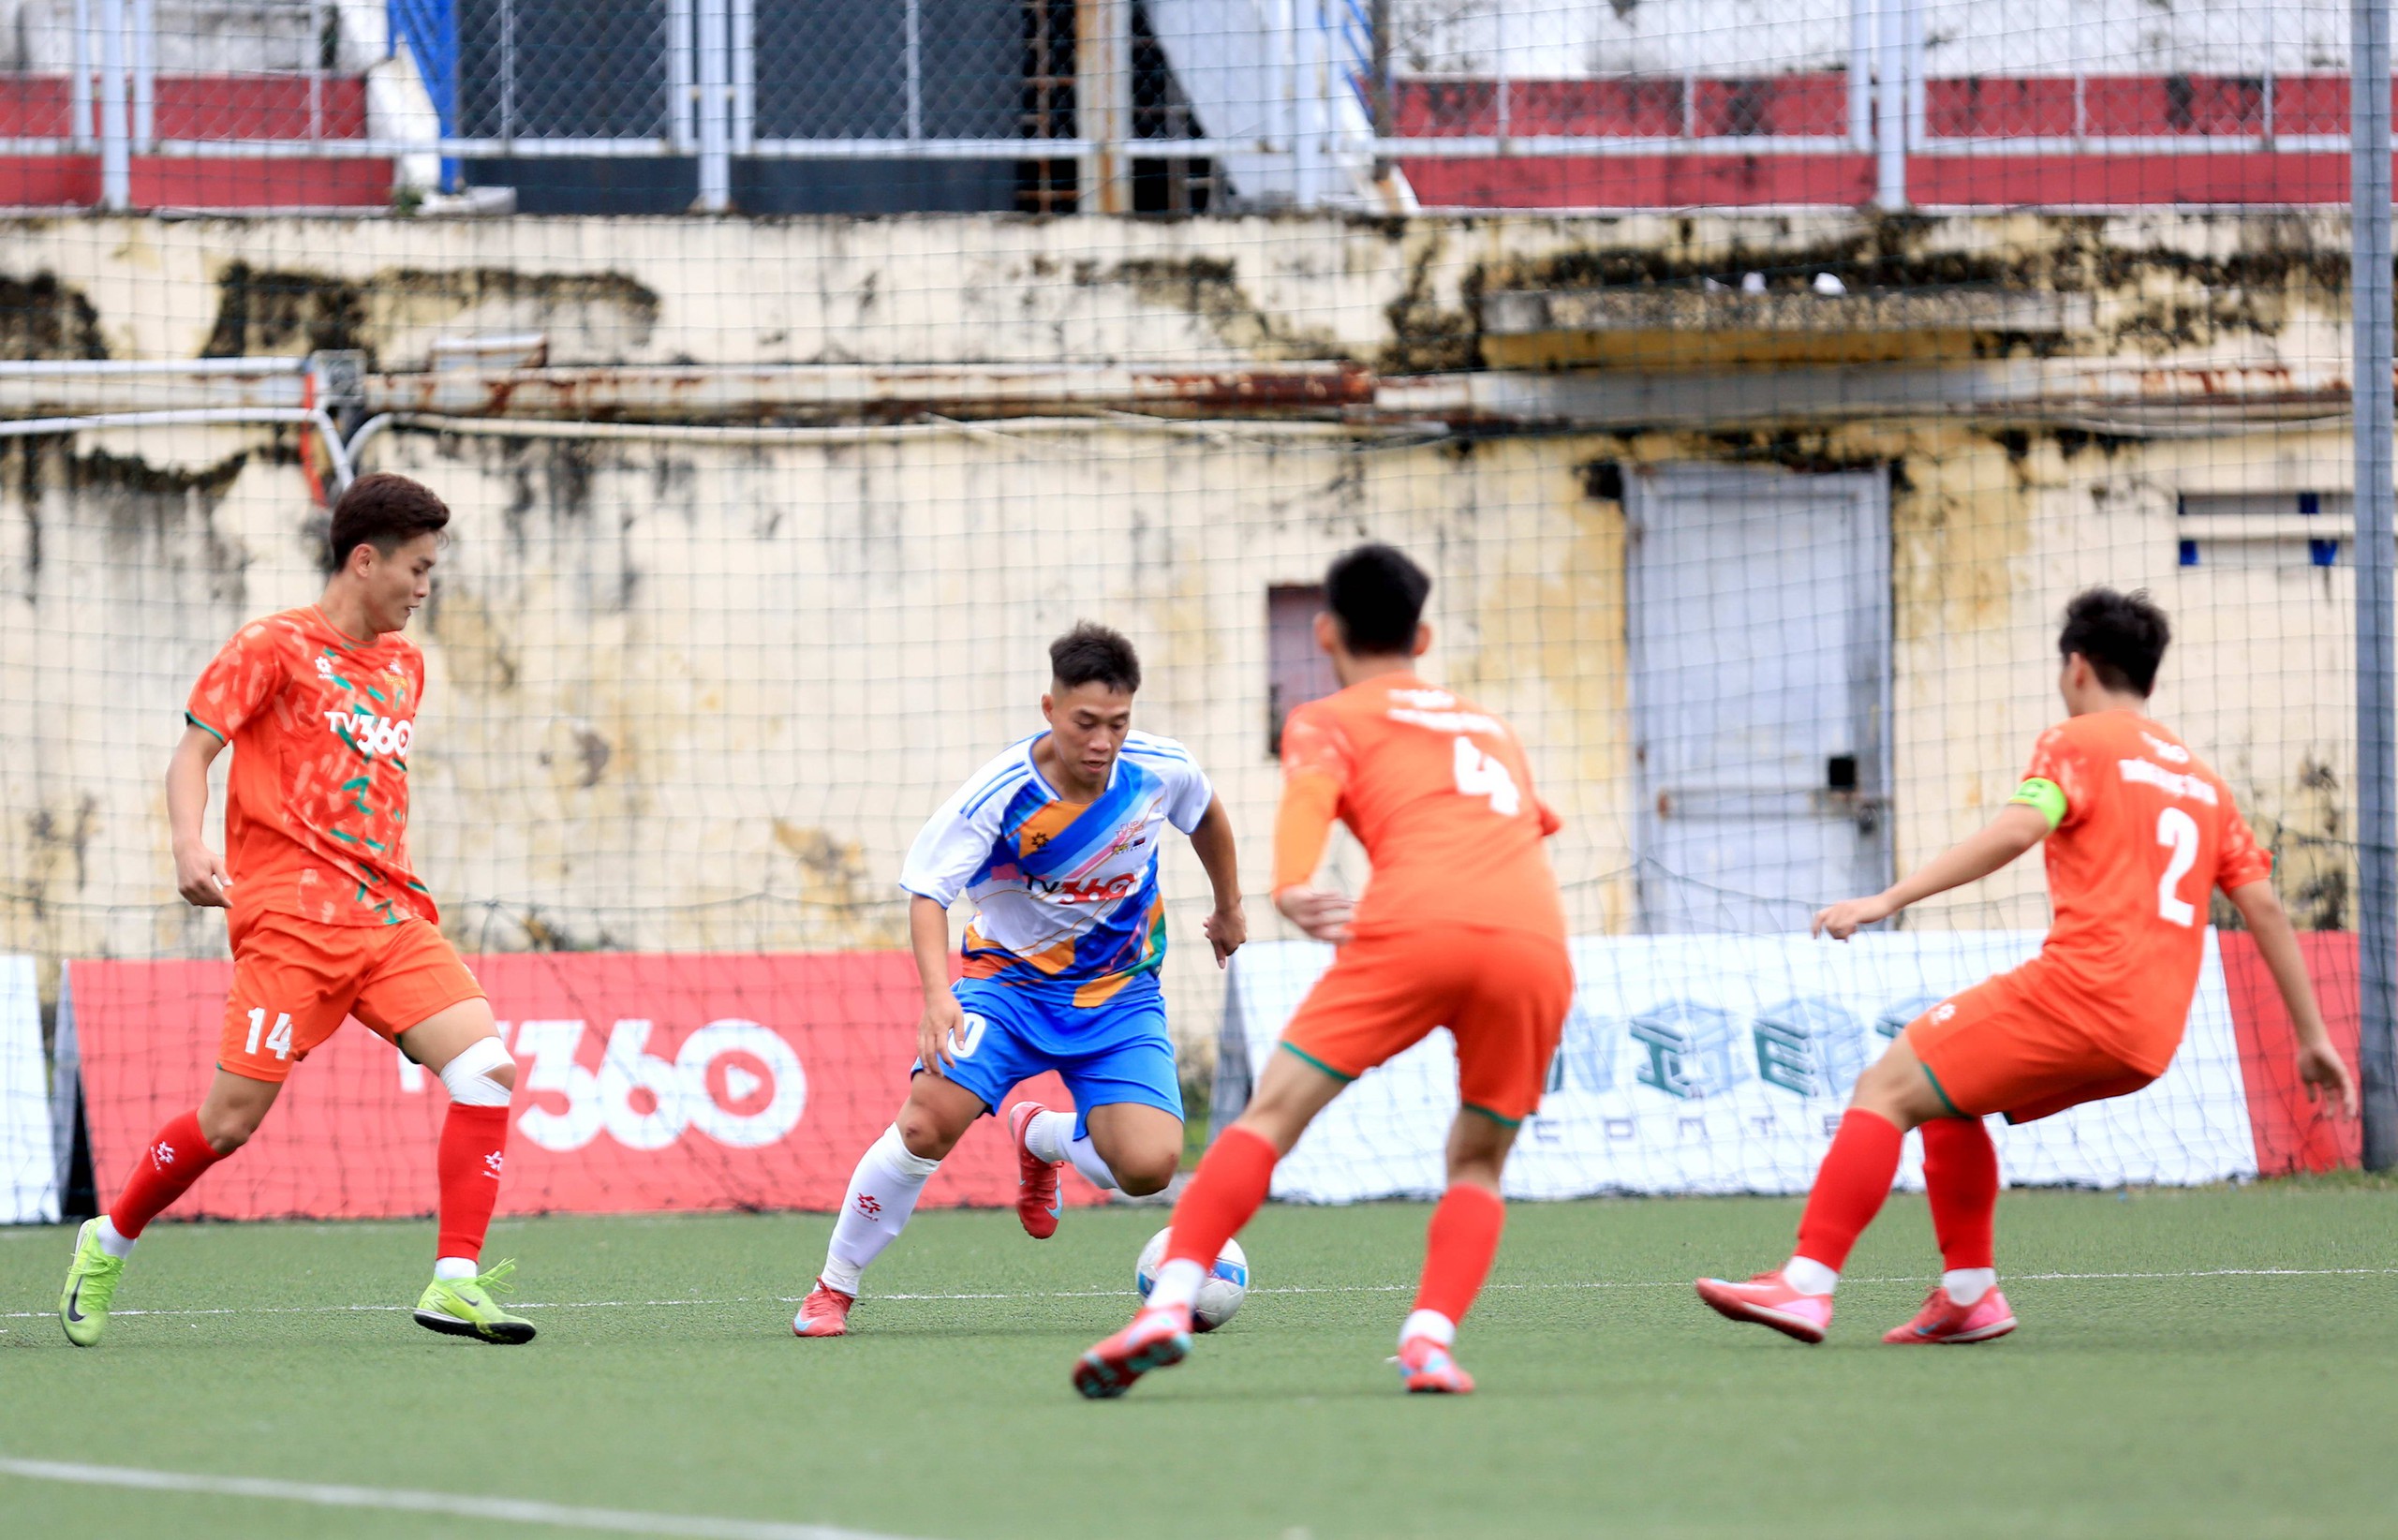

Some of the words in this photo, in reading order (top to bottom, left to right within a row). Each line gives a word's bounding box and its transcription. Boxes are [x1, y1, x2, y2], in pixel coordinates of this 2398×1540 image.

[323, 711, 412, 756] TV360
[1454, 735, 1519, 816] 4
[1023, 870, 1135, 905] TV360
[2156, 807, 2198, 926] 2
[244, 1007, 293, 1059] 14
[368, 1017, 807, 1151] 360
[1532, 1114, 1843, 1141] CONTE
